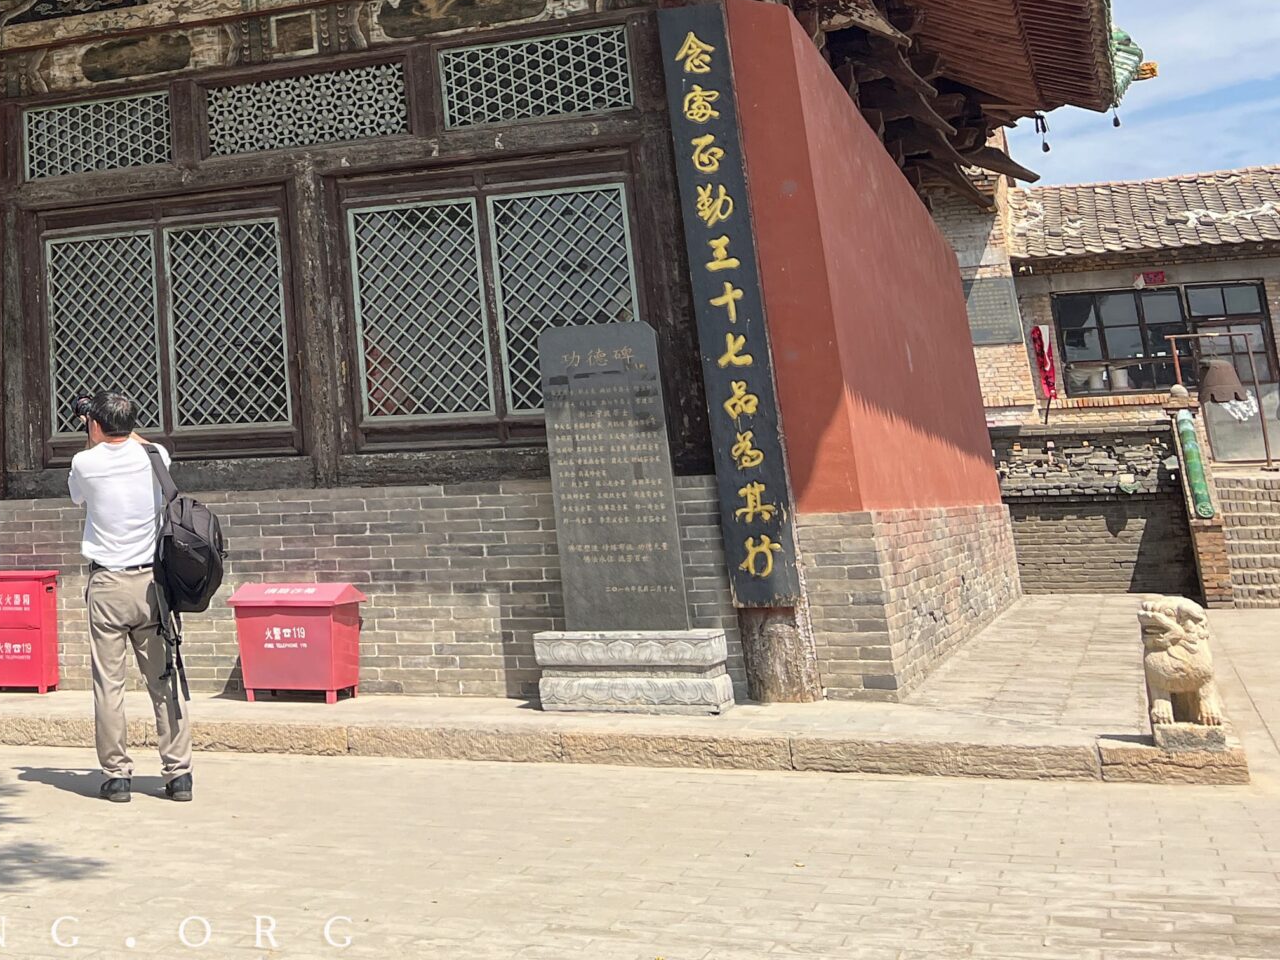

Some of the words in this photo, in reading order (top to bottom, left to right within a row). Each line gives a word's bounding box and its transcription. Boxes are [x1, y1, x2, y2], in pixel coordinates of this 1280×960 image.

[562, 346, 634, 368] 功德碑
[292, 626, 306, 639] 119
